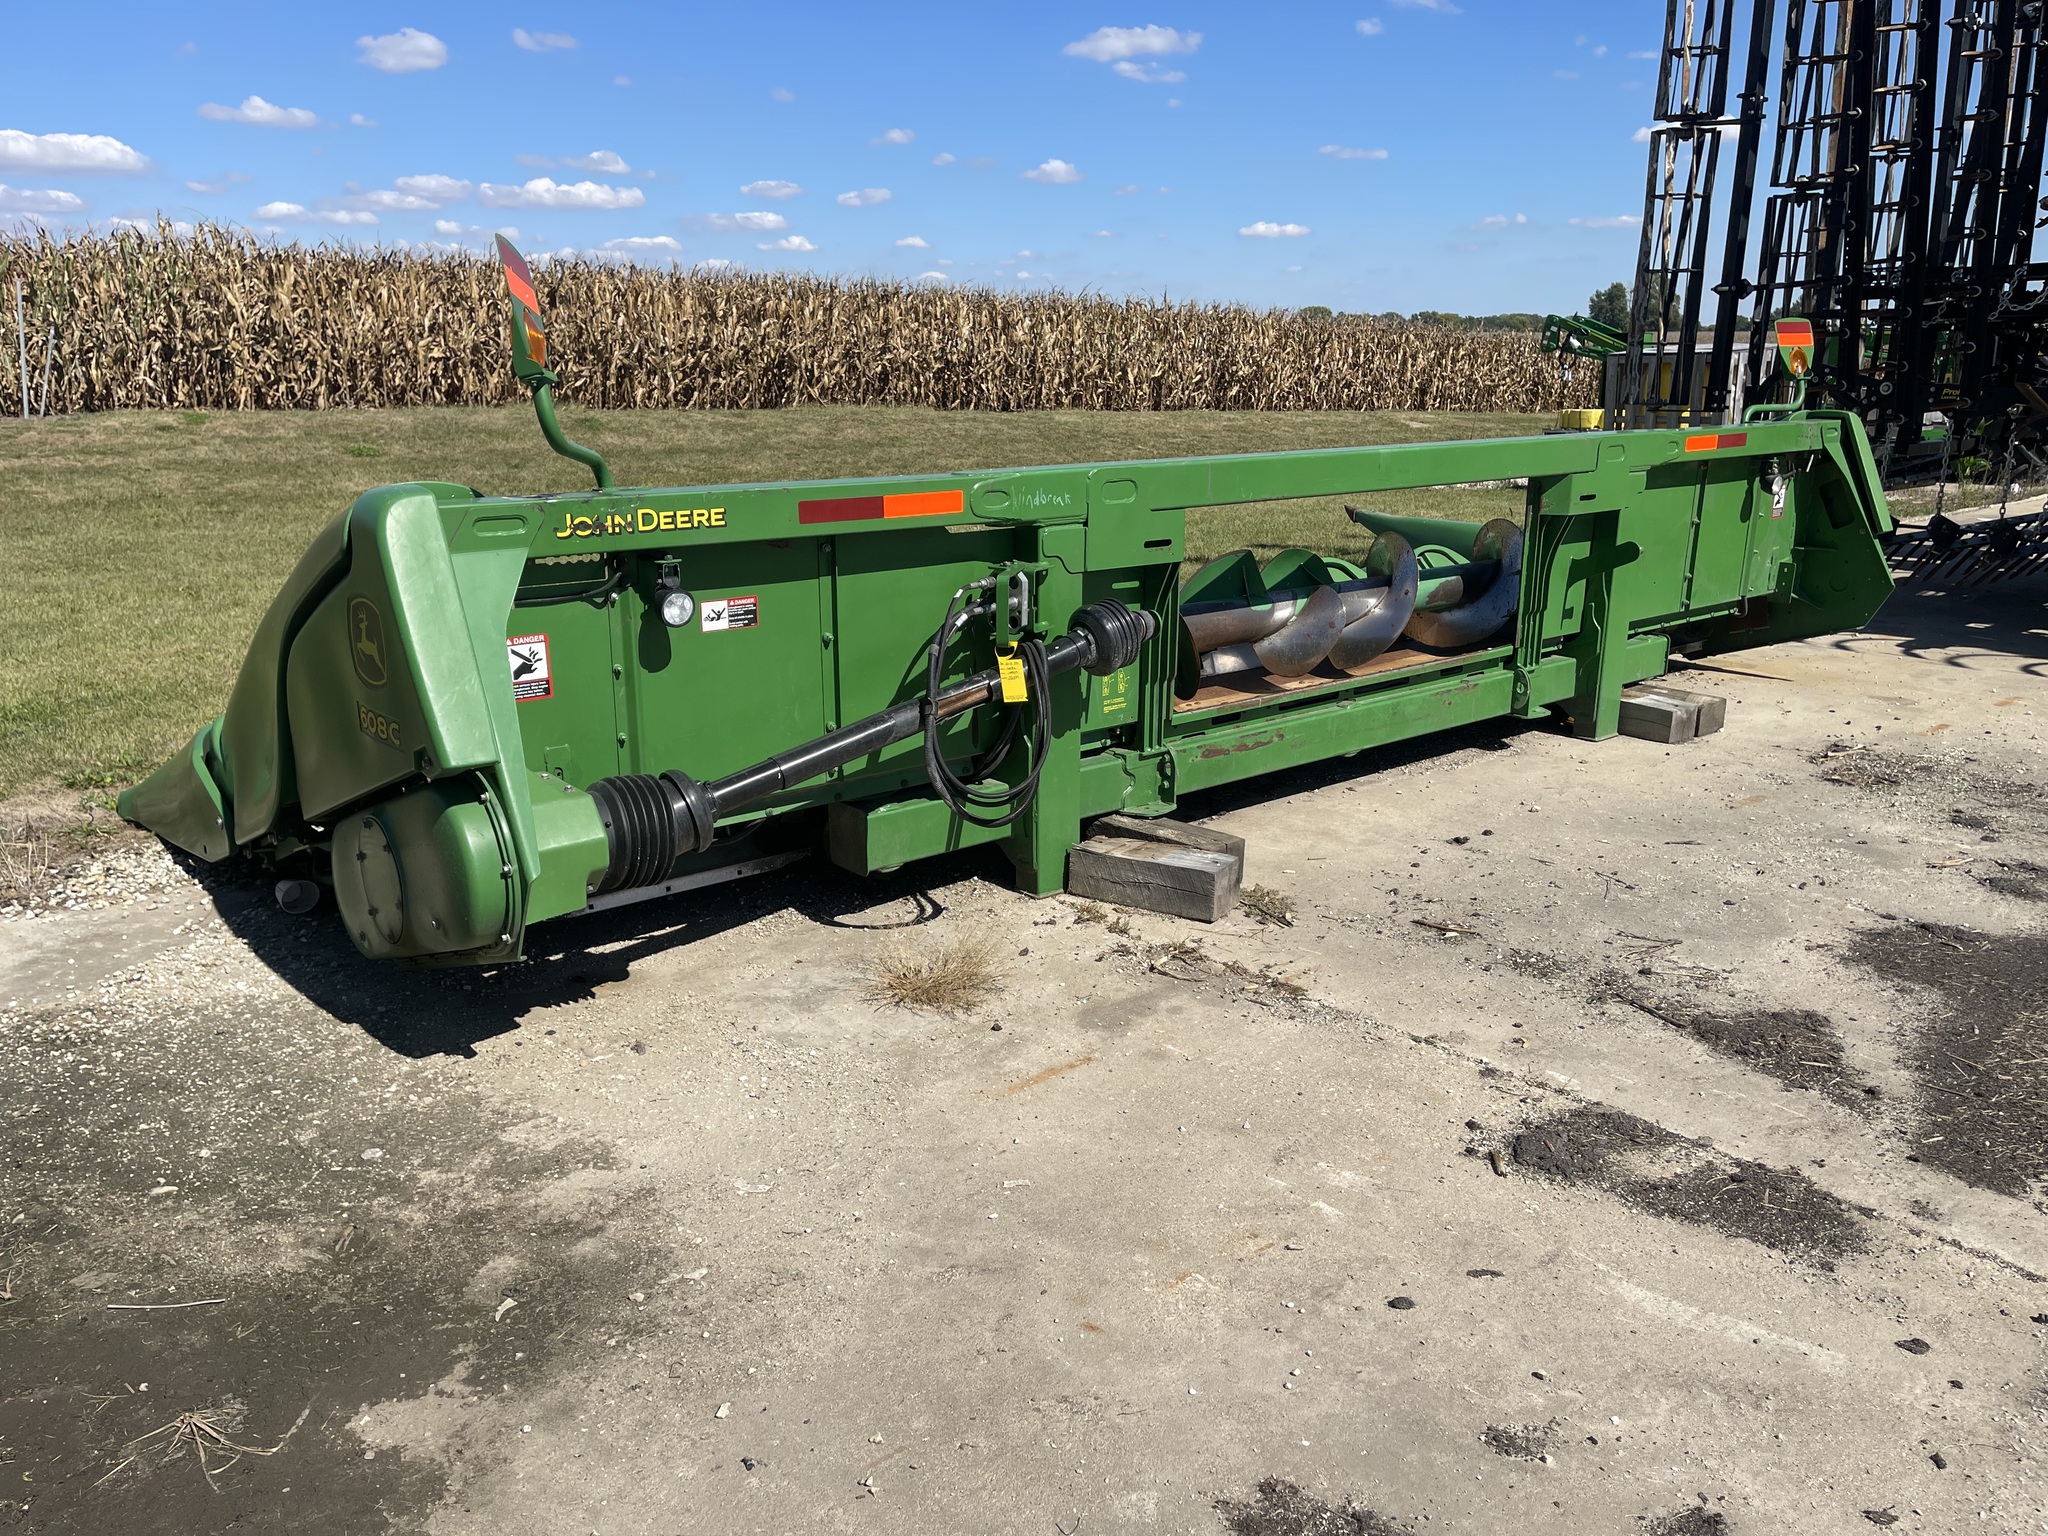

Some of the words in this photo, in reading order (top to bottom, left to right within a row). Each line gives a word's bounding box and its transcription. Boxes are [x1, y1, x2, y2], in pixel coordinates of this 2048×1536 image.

[556, 513, 634, 539] JOHN
[637, 507, 727, 532] DEERE
[513, 634, 544, 645] DANGER
[360, 706, 400, 746] 608C
